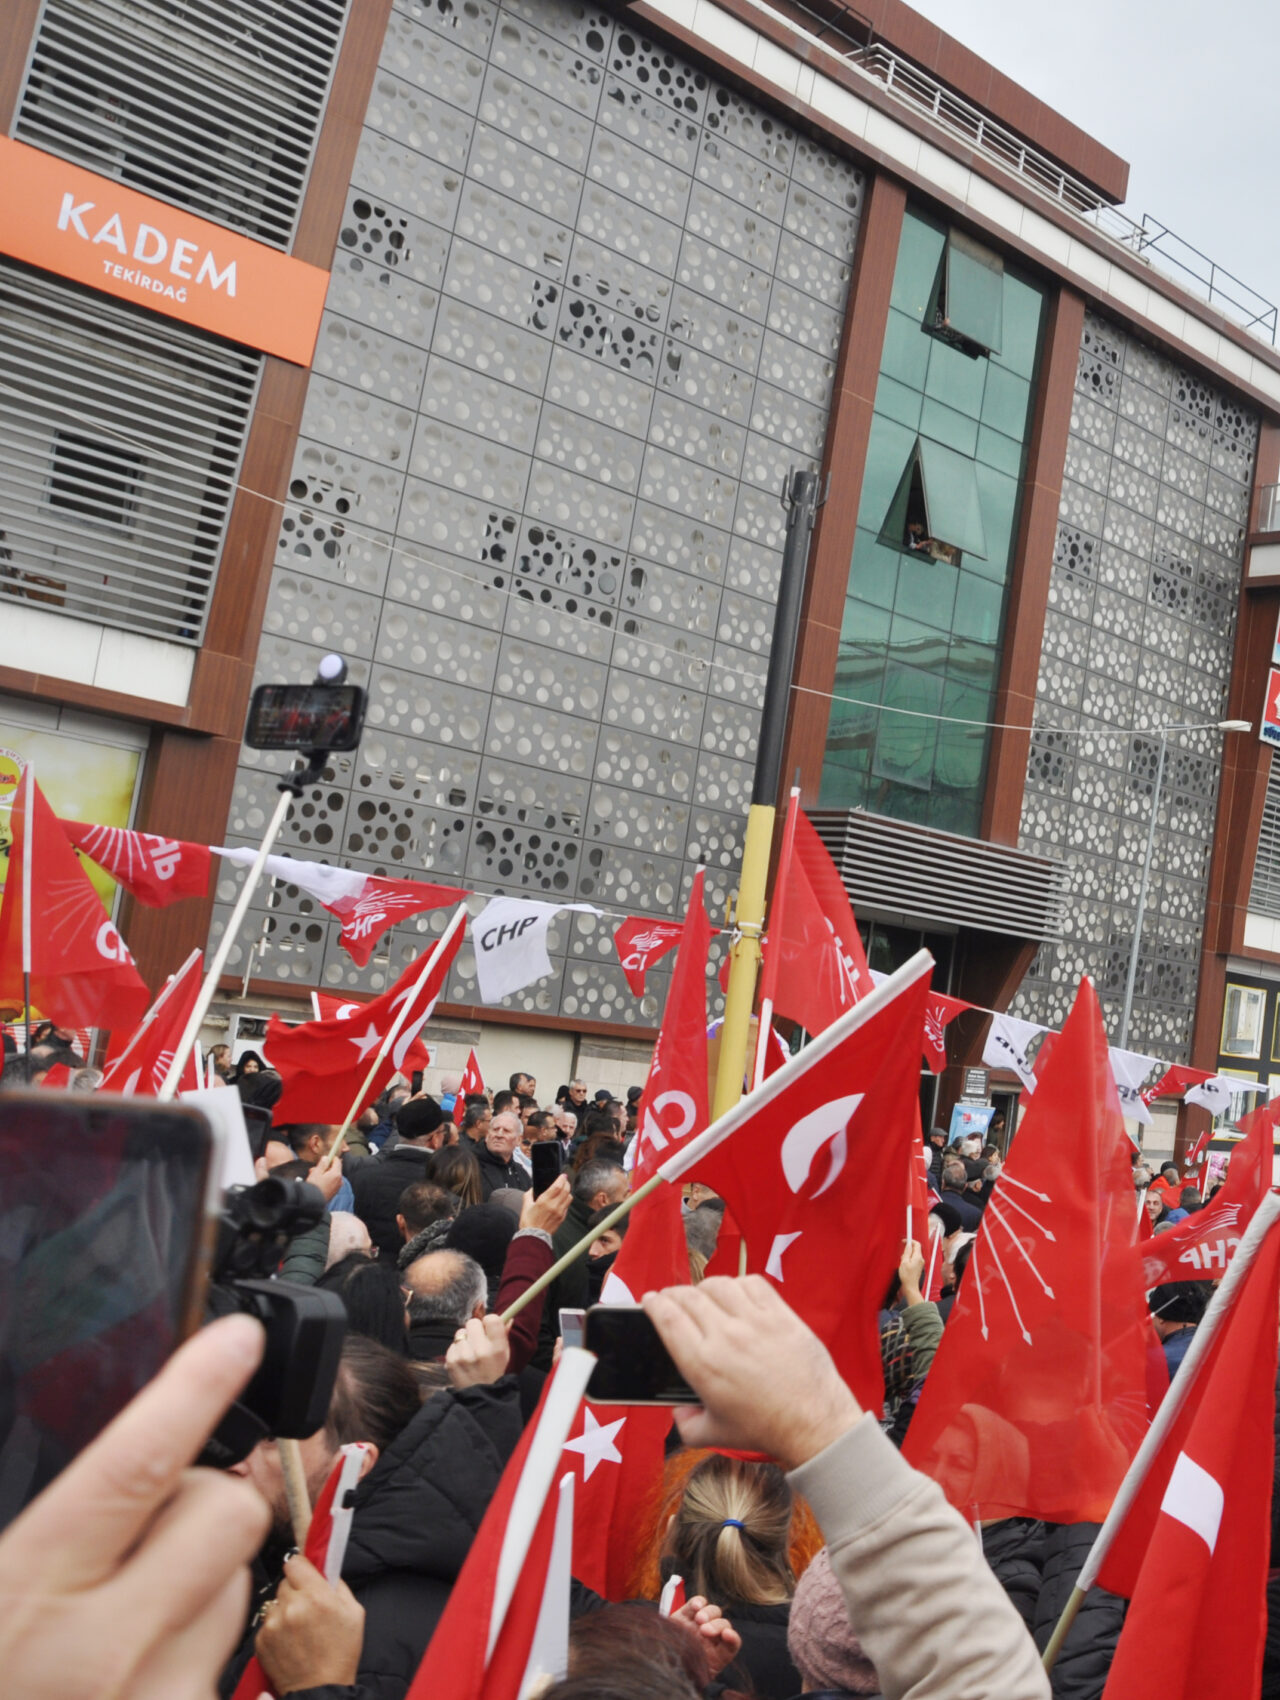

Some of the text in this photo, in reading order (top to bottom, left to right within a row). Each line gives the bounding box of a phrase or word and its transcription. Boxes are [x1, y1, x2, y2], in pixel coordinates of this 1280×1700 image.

[57, 192, 238, 297] KADEM
[103, 260, 188, 303] TEKİRDAĞ
[481, 916, 539, 952] CHP
